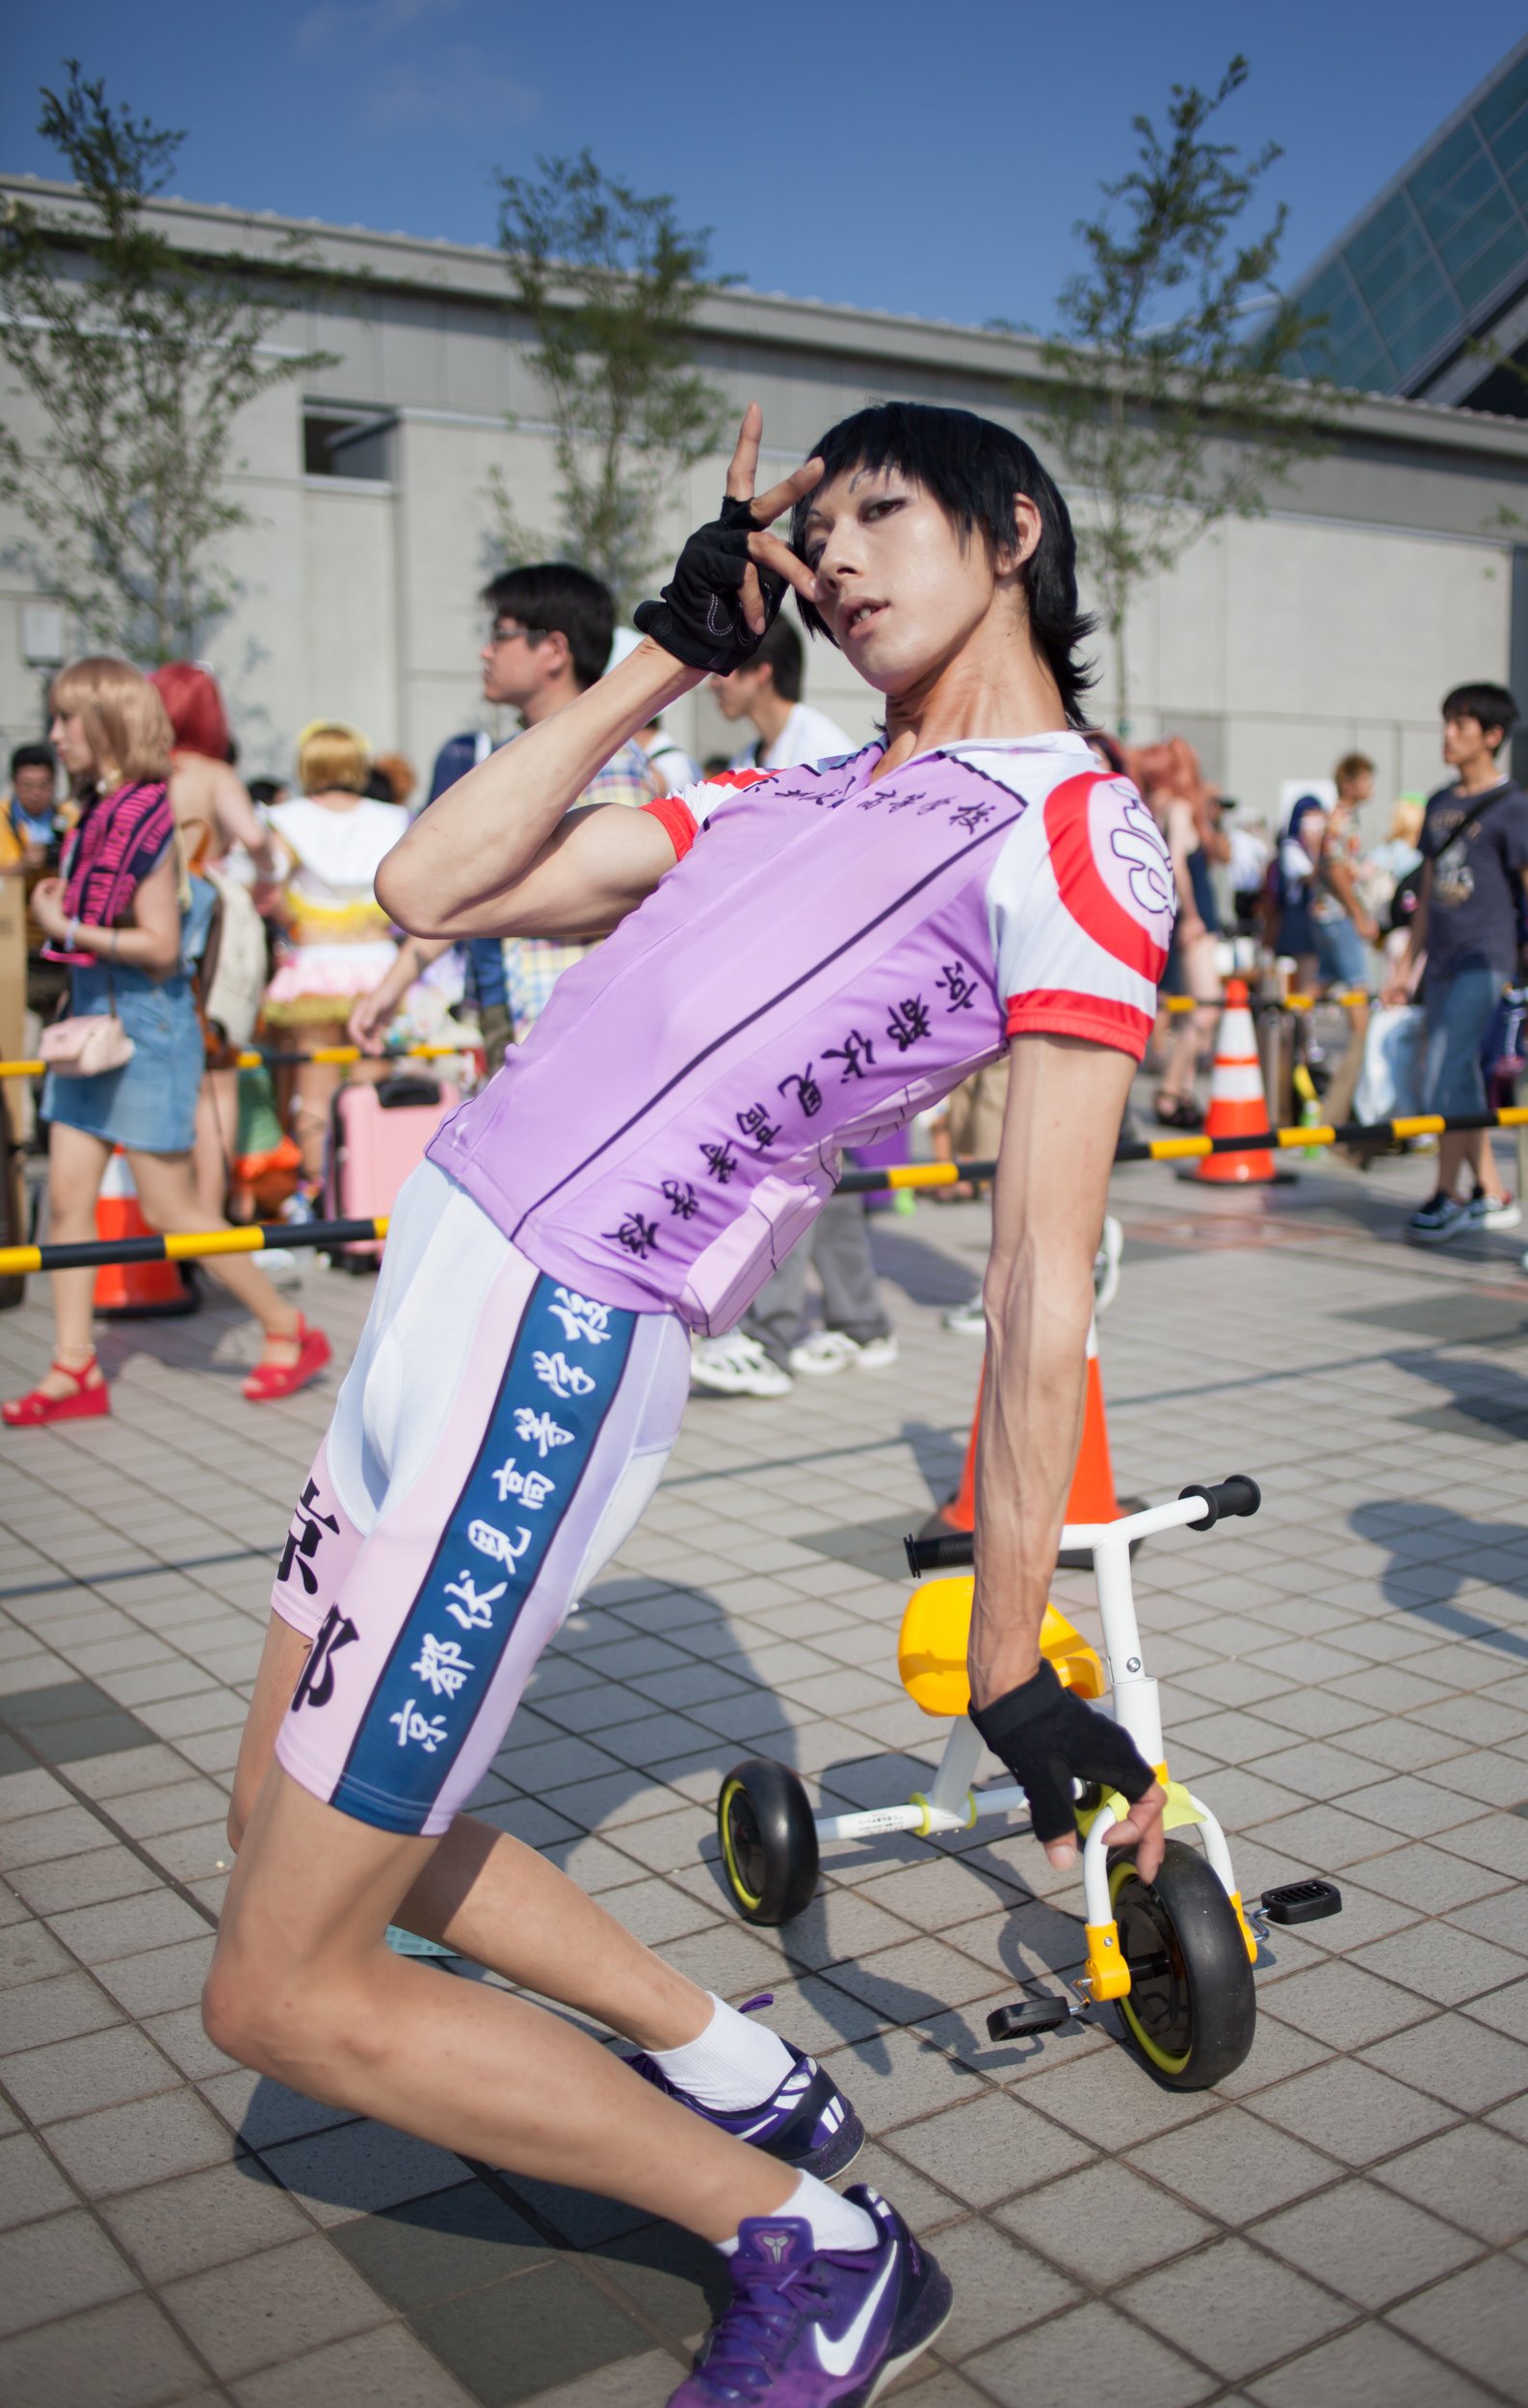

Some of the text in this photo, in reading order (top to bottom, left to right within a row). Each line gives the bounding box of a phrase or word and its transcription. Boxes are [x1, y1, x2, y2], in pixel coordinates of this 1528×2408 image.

[600, 960, 980, 1261] 京都伏見高等学校
[388, 1286, 615, 1754] 京都伏見高等学校
